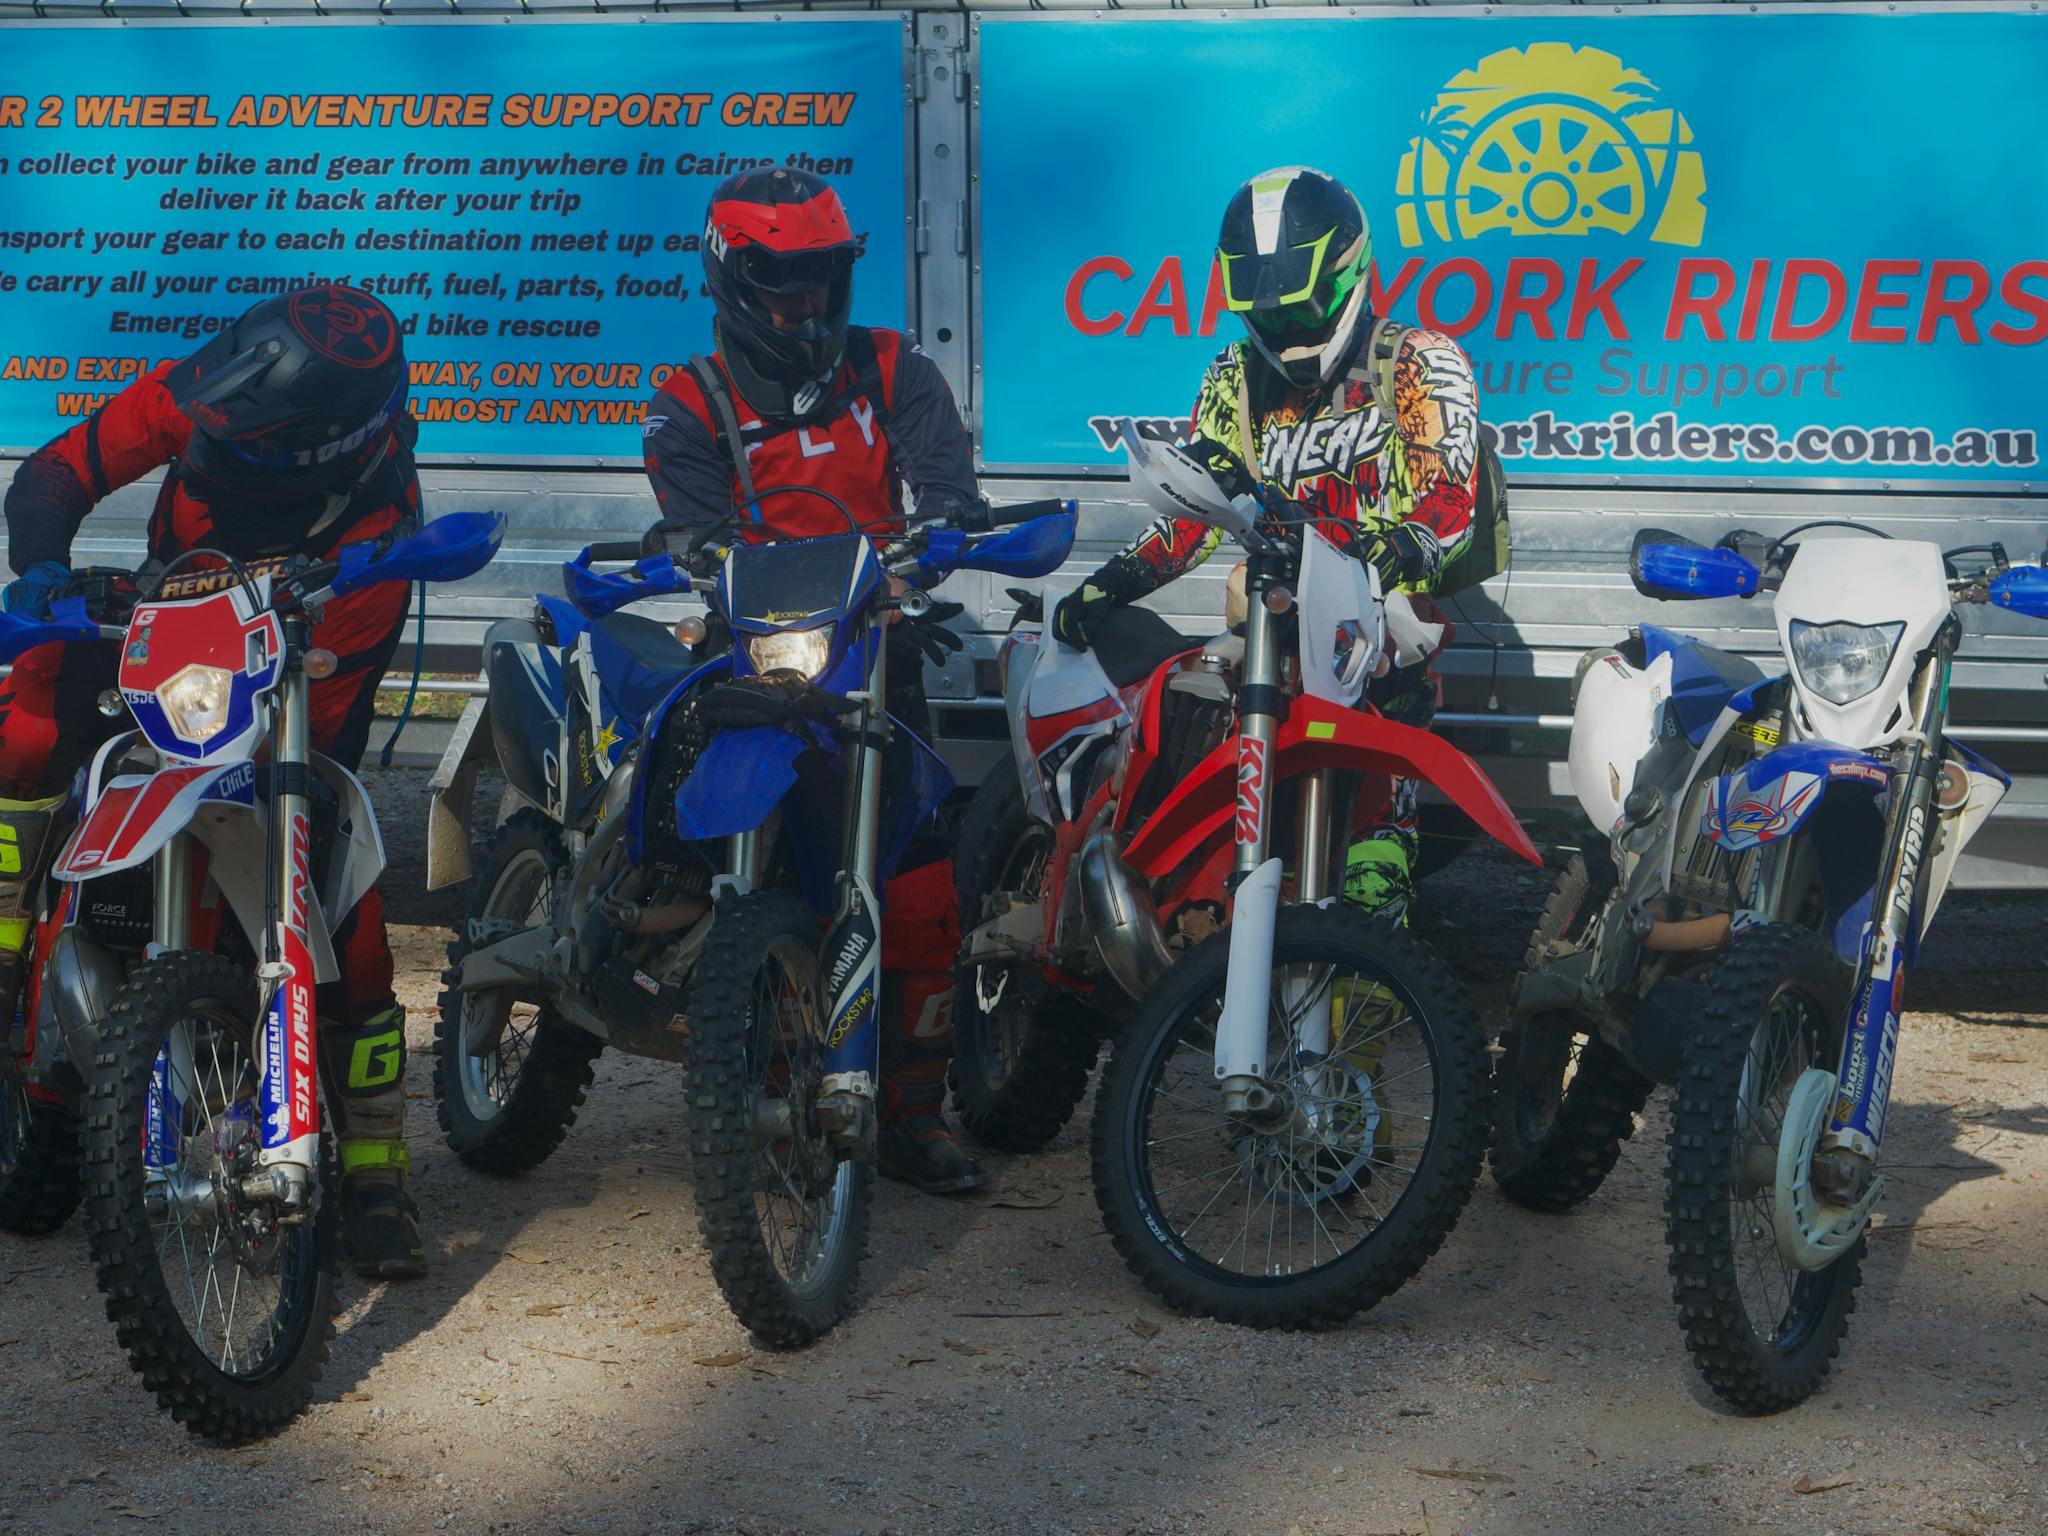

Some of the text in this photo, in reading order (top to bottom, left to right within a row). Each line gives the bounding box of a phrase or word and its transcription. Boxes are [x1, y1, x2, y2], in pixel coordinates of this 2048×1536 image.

[35, 95, 64, 128] 2
[74, 95, 218, 128] WHEEL
[227, 94, 492, 127] ADVENTURE
[502, 93, 712, 127] SUPPORT
[720, 92, 857, 127] CREW
[18, 152, 117, 176] collect
[122, 156, 188, 181] your
[195, 152, 257, 176] bike
[265, 152, 319, 176] and
[325, 156, 395, 181] gear
[402, 152, 471, 176] from
[479, 152, 628, 182] anywhere
[637, 152, 665, 176] in
[159, 187, 581, 217] deliver it back after your trip
[92, 230, 157, 256] your
[162, 230, 229, 256] gear
[237, 228, 267, 250] to
[275, 226, 346, 252] each
[355, 228, 522, 252] destination
[530, 229, 608, 253] meet
[616, 231, 654, 258] up
[704, 216, 730, 264] FLY
[26, 273, 104, 298] carry
[110, 271, 147, 293] all
[151, 274, 219, 299] your
[357, 271, 433, 297] stuff,
[443, 272, 508, 300] fuel,
[517, 274, 605, 301] parts,
[615, 273, 690, 302] food,
[1064, 255, 2048, 346] CAP YORK RIDERS
[109, 311, 237, 340] Emergen
[427, 313, 489, 337] bike
[498, 317, 601, 338] rescue
[2, 356, 68, 381] AND
[75, 356, 170, 382] EXPL
[491, 362, 542, 388] ON
[550, 362, 642, 389] YOUR
[1594, 347, 1847, 408] Support
[408, 397, 519, 423] LMOST
[524, 399, 652, 425] ANYWH
[1235, 734, 1267, 846] KYB
[827, 931, 869, 994] YAMAHA
[268, 1011, 282, 1104] MICHELIN
[292, 984, 311, 1126] SIX DAYS
[1839, 1030, 1866, 1098] boost
